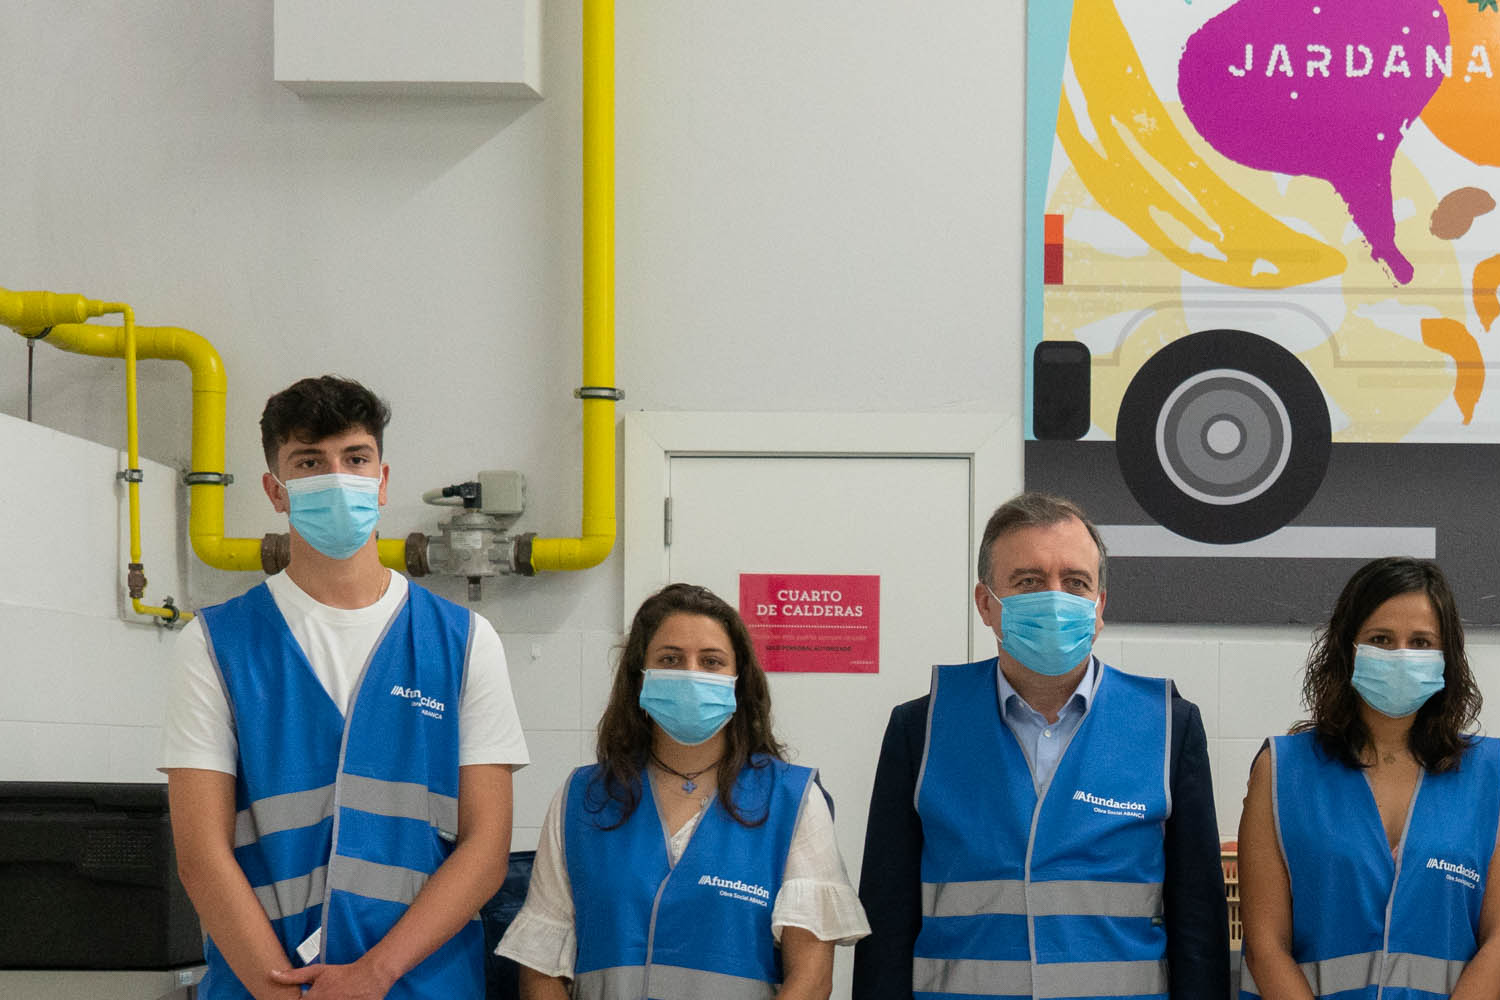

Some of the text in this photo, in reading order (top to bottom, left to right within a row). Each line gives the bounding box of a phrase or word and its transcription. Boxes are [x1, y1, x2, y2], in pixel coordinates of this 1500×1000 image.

[777, 590, 842, 602] CUARTO
[757, 605, 863, 616] DE CALDERAS
